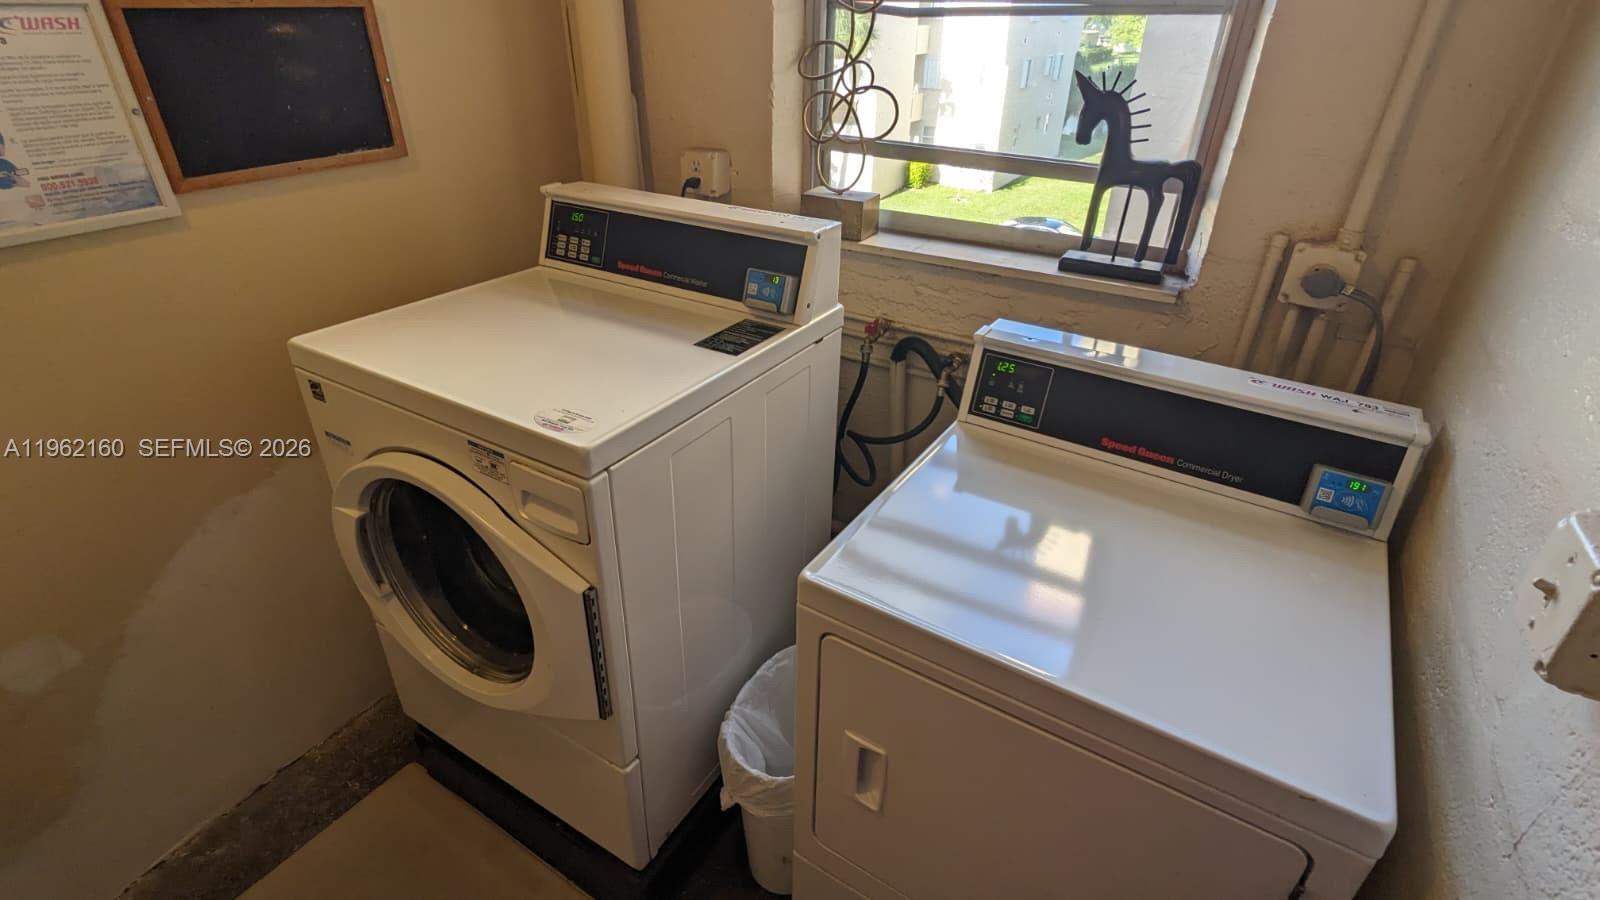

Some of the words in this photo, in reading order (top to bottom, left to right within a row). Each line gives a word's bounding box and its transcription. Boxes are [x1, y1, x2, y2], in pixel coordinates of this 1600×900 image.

[20, 16, 81, 31] WASH
[1101, 437, 1137, 454] Speed
[1137, 447, 1174, 464] Queen
[1176, 458, 1221, 477] Commercial
[1221, 471, 1244, 483] Dryer
[1349, 480, 1368, 493] 191
